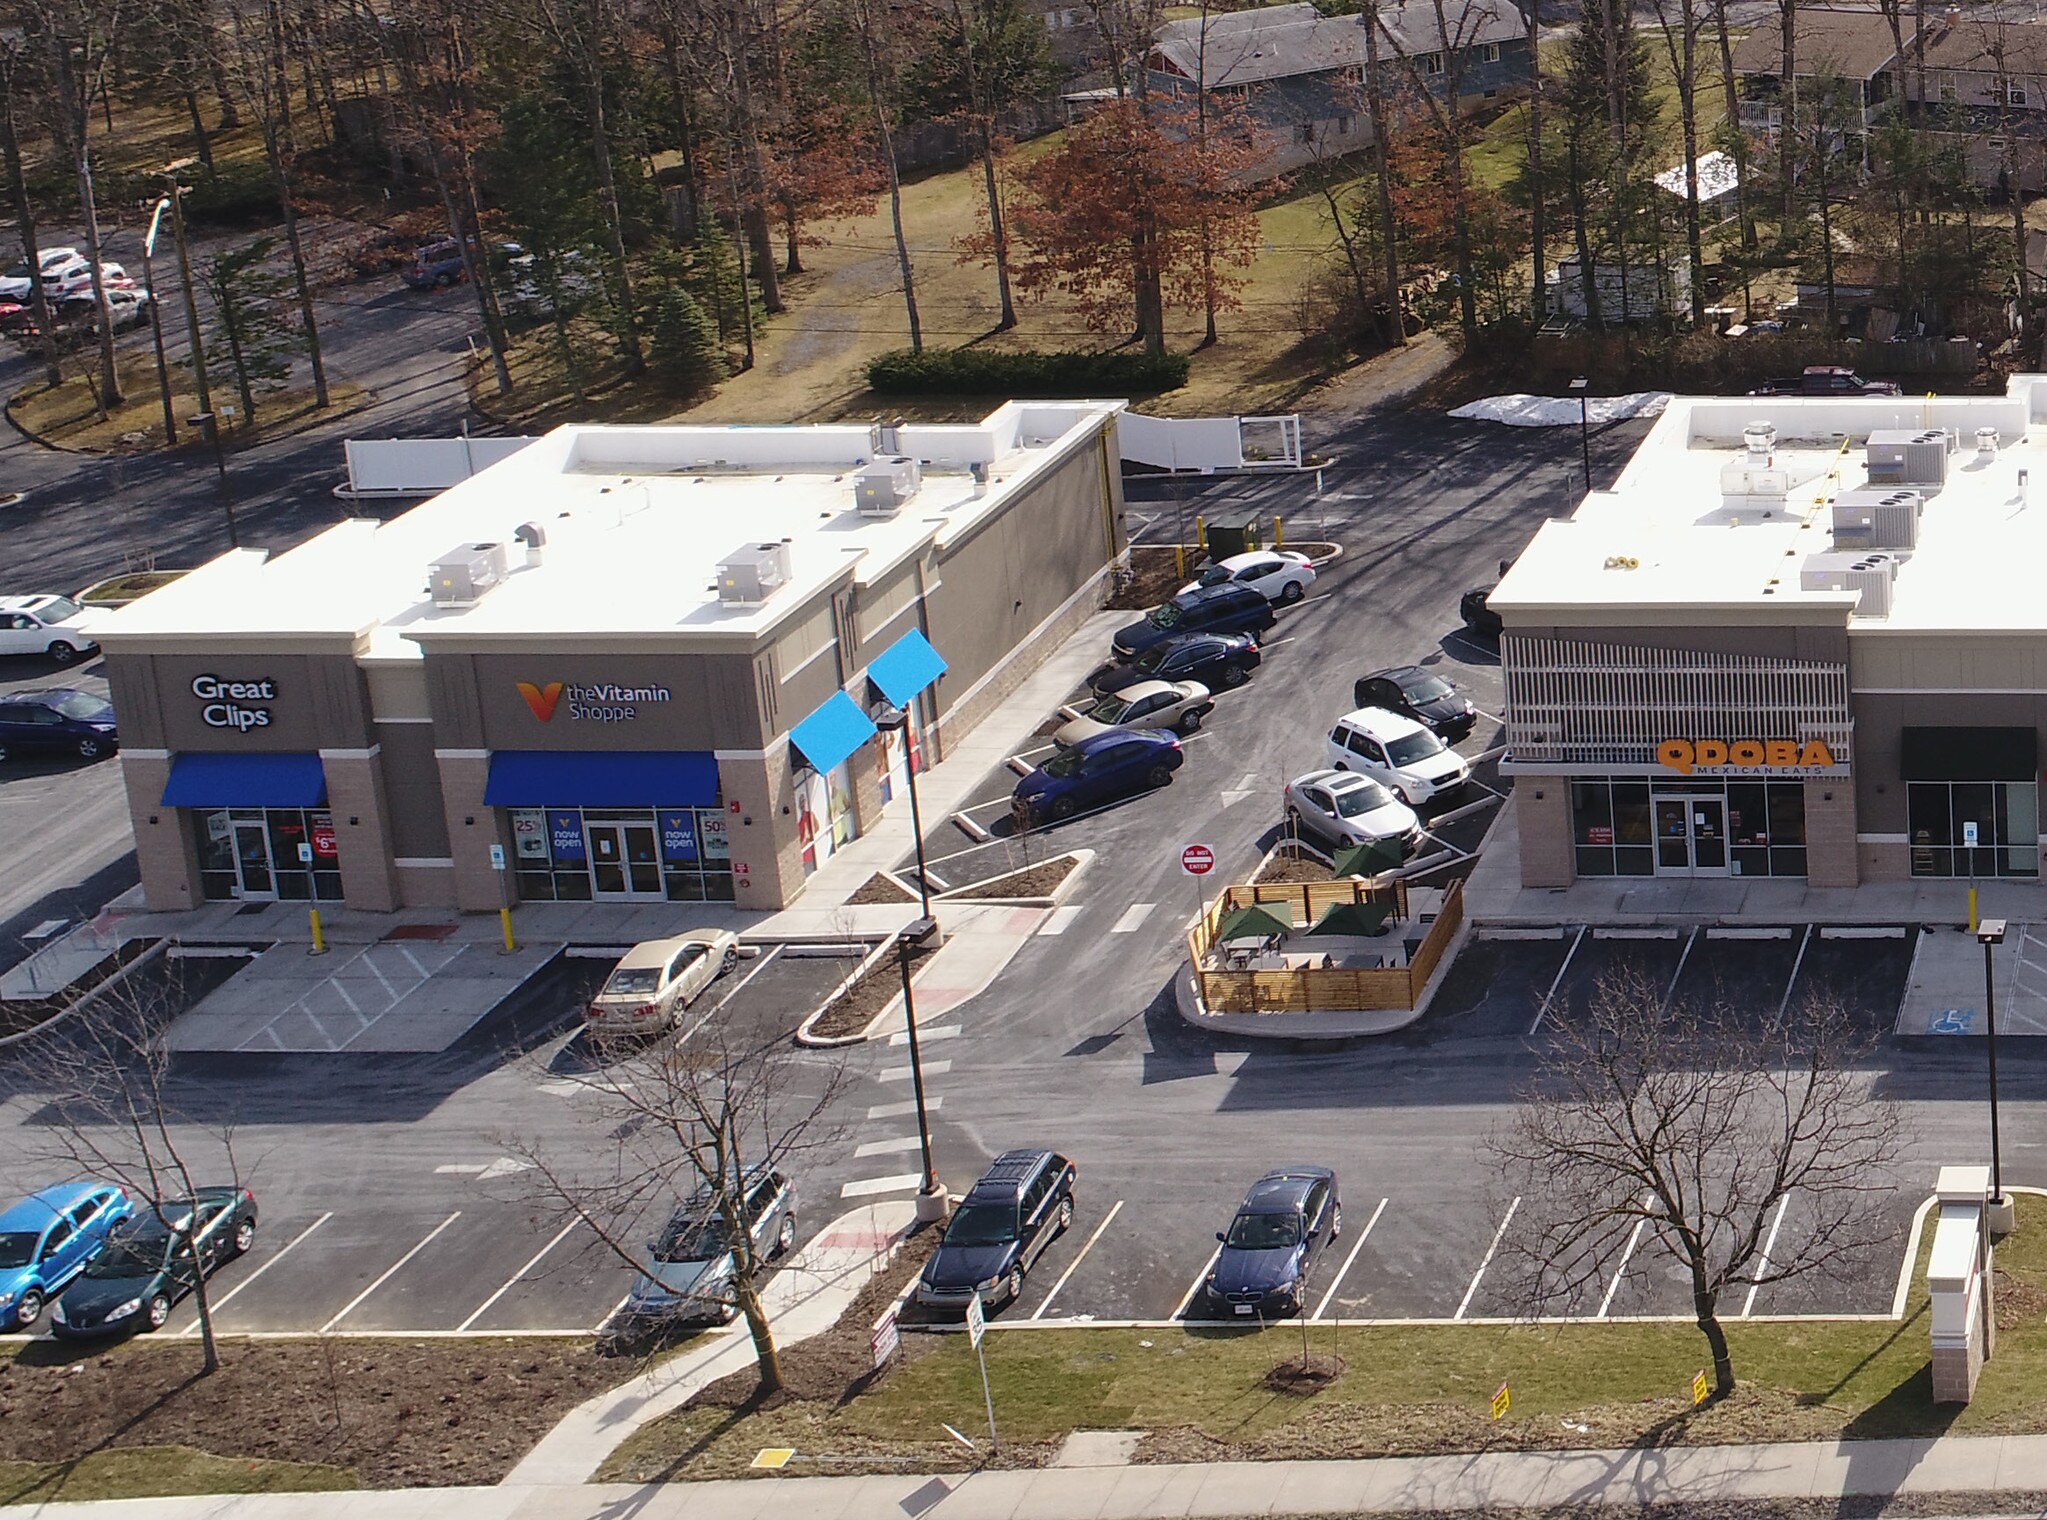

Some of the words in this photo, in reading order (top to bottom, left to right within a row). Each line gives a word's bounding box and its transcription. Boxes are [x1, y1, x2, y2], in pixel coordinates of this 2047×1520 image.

[192, 676, 275, 699] Great
[203, 703, 270, 732] Clips
[569, 703, 636, 723] Shoppe
[1657, 739, 1835, 776] QDOBA
[1697, 767, 1774, 775] MEXICAN
[1781, 767, 1823, 775] EATS
[554, 830, 580, 839] now
[665, 831, 691, 839] now
[554, 840, 582, 850] open
[665, 839, 694, 850] open
